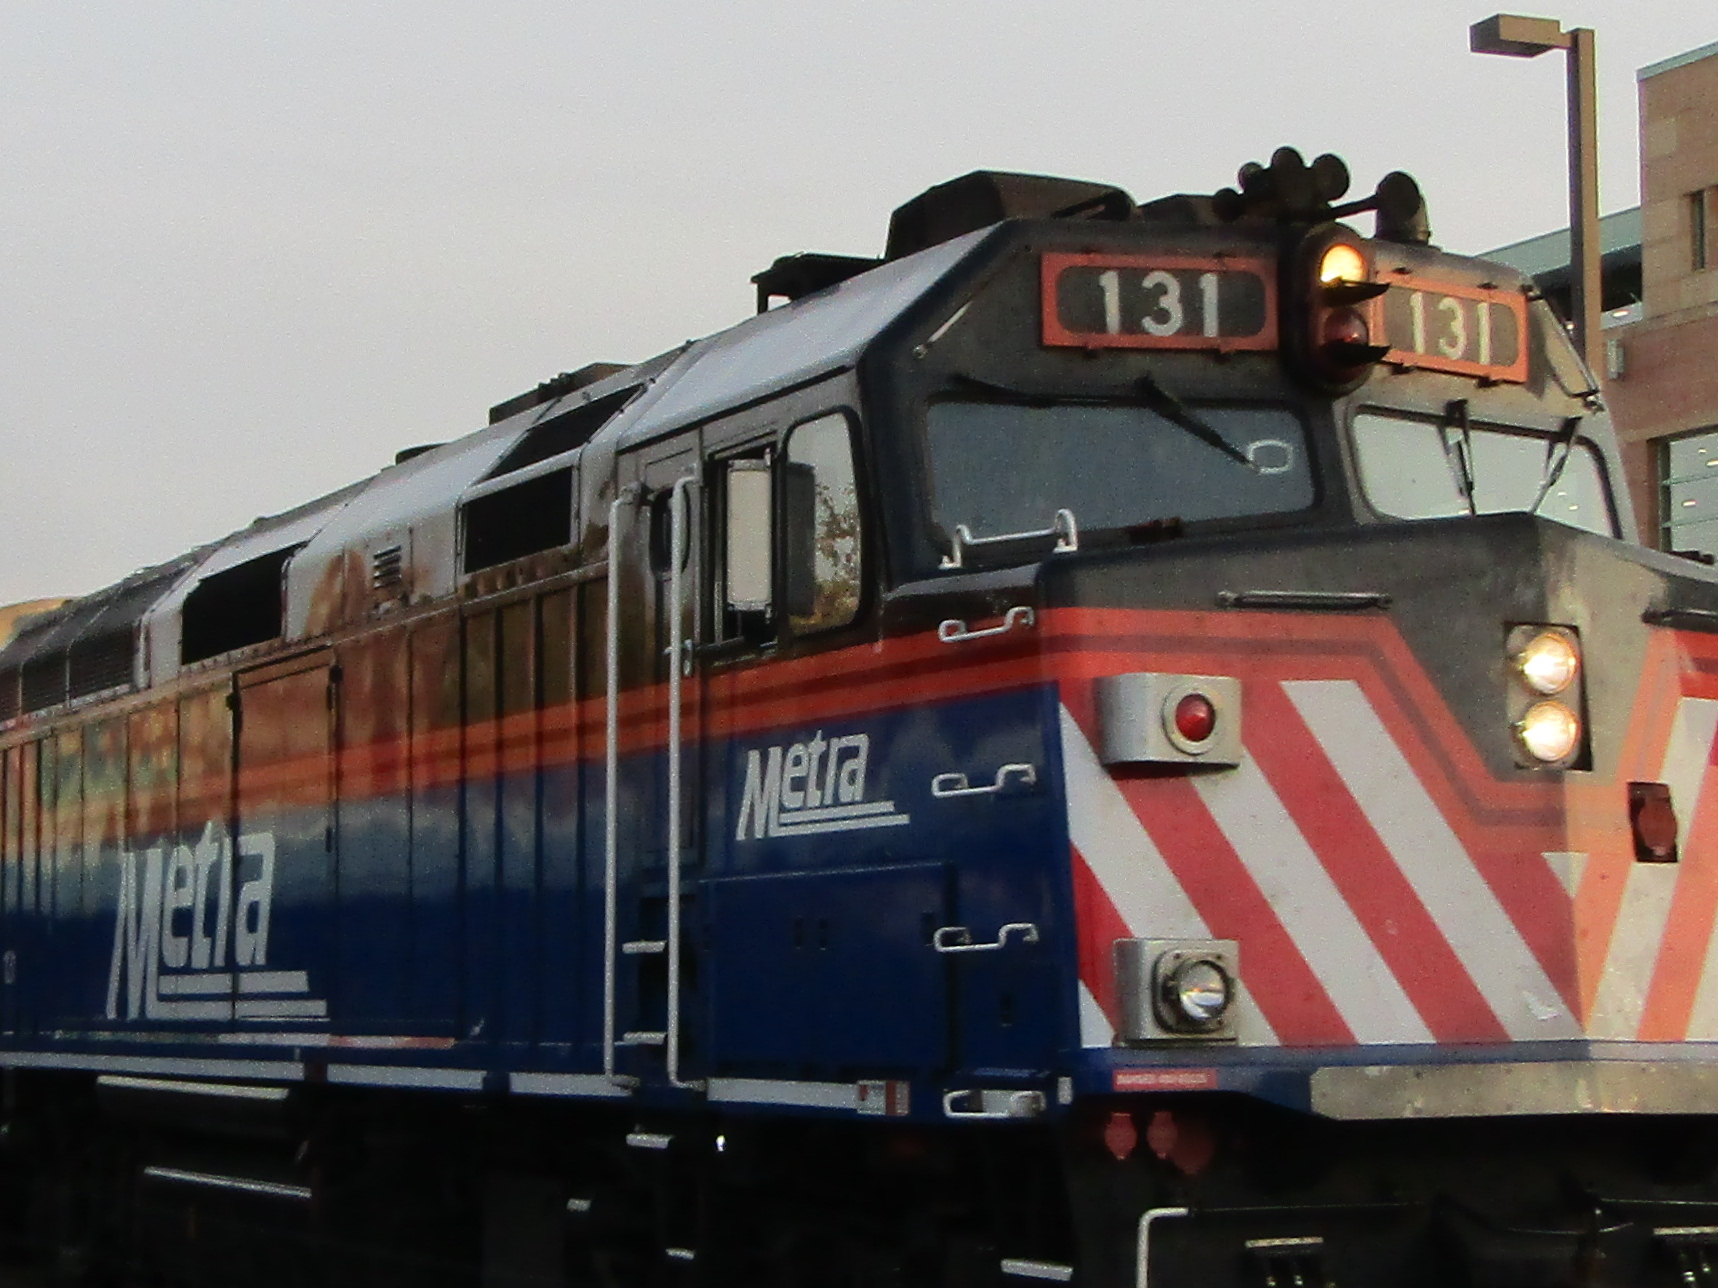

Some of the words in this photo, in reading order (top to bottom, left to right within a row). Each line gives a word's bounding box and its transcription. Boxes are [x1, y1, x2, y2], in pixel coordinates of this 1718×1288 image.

[1099, 270, 1220, 338] 131
[1409, 291, 1491, 365] 131
[736, 729, 870, 841] Metra
[106, 819, 276, 1020] Metra
